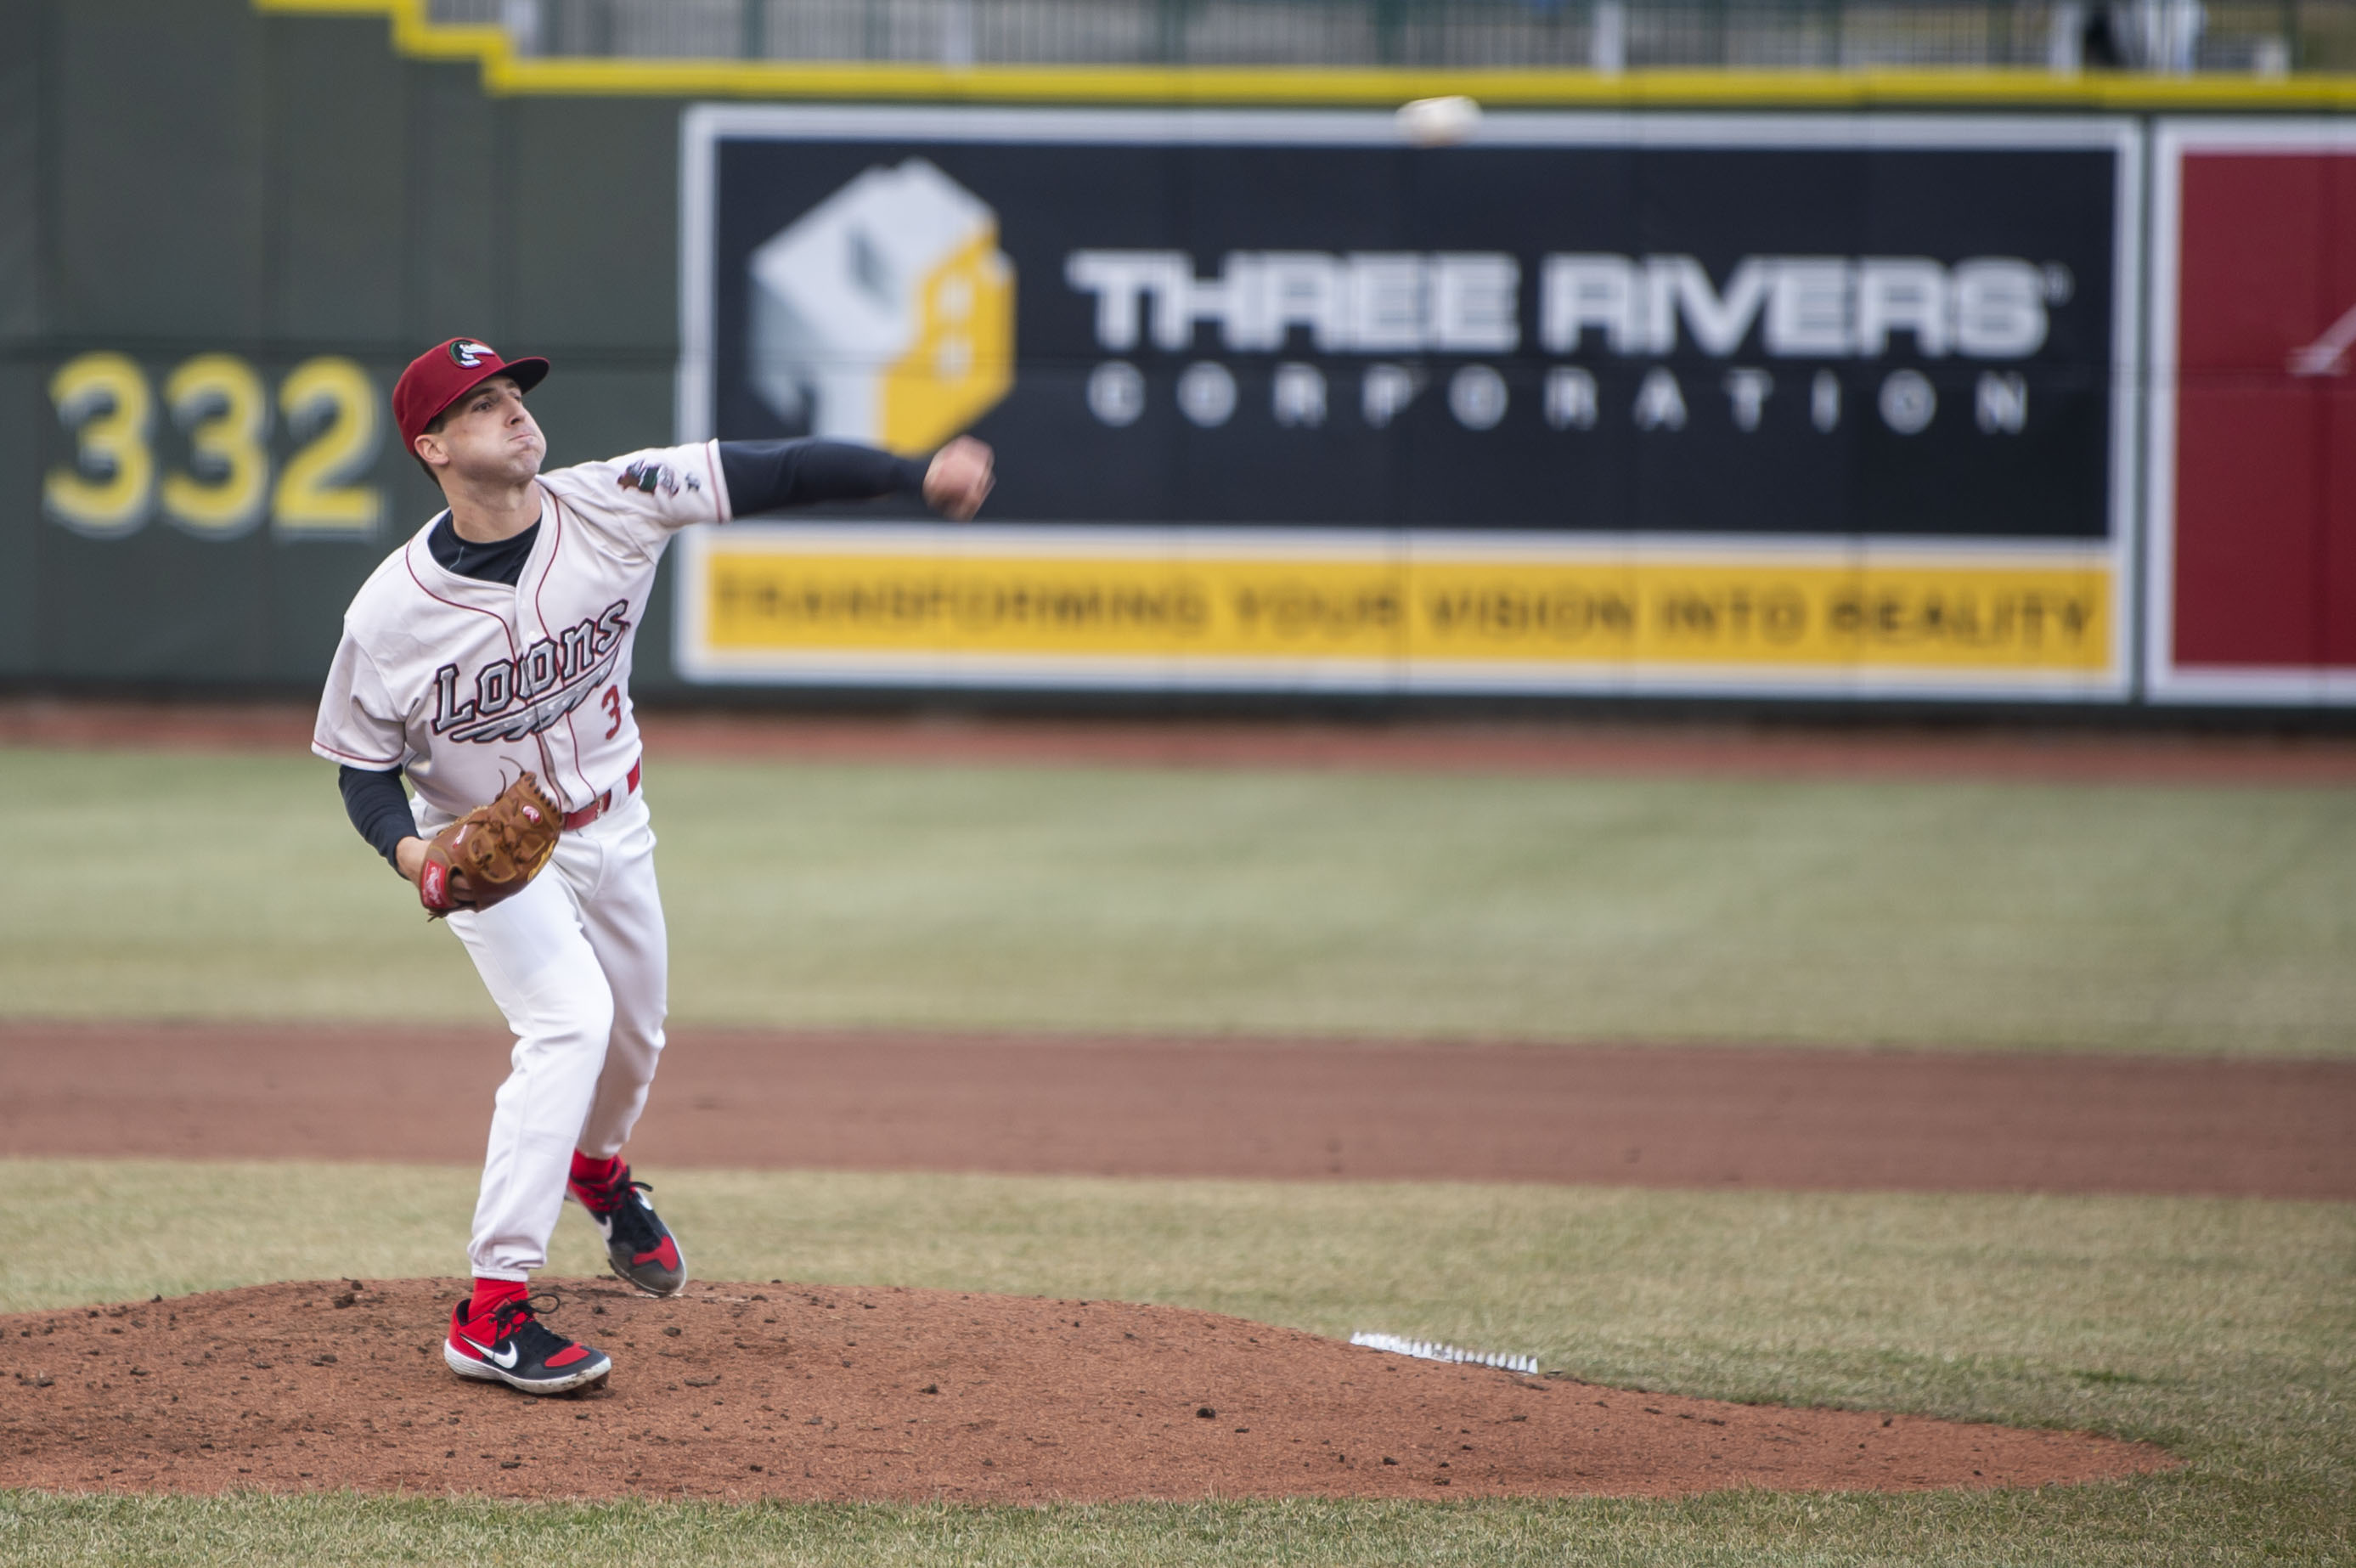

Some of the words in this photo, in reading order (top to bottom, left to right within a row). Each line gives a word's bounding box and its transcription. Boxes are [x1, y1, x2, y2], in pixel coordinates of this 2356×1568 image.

[1064, 250, 1520, 353] THREE
[1086, 358, 2030, 435] CORPORATION
[44, 350, 391, 544] 332
[715, 567, 1209, 639] TRANSFORMING
[1230, 576, 1403, 643] YOUR
[1423, 581, 1636, 646] VISION
[1656, 586, 1809, 649] INTO
[1824, 588, 2093, 649] REALITY
[431, 598, 630, 736] Loons
[601, 685, 622, 741] 3
